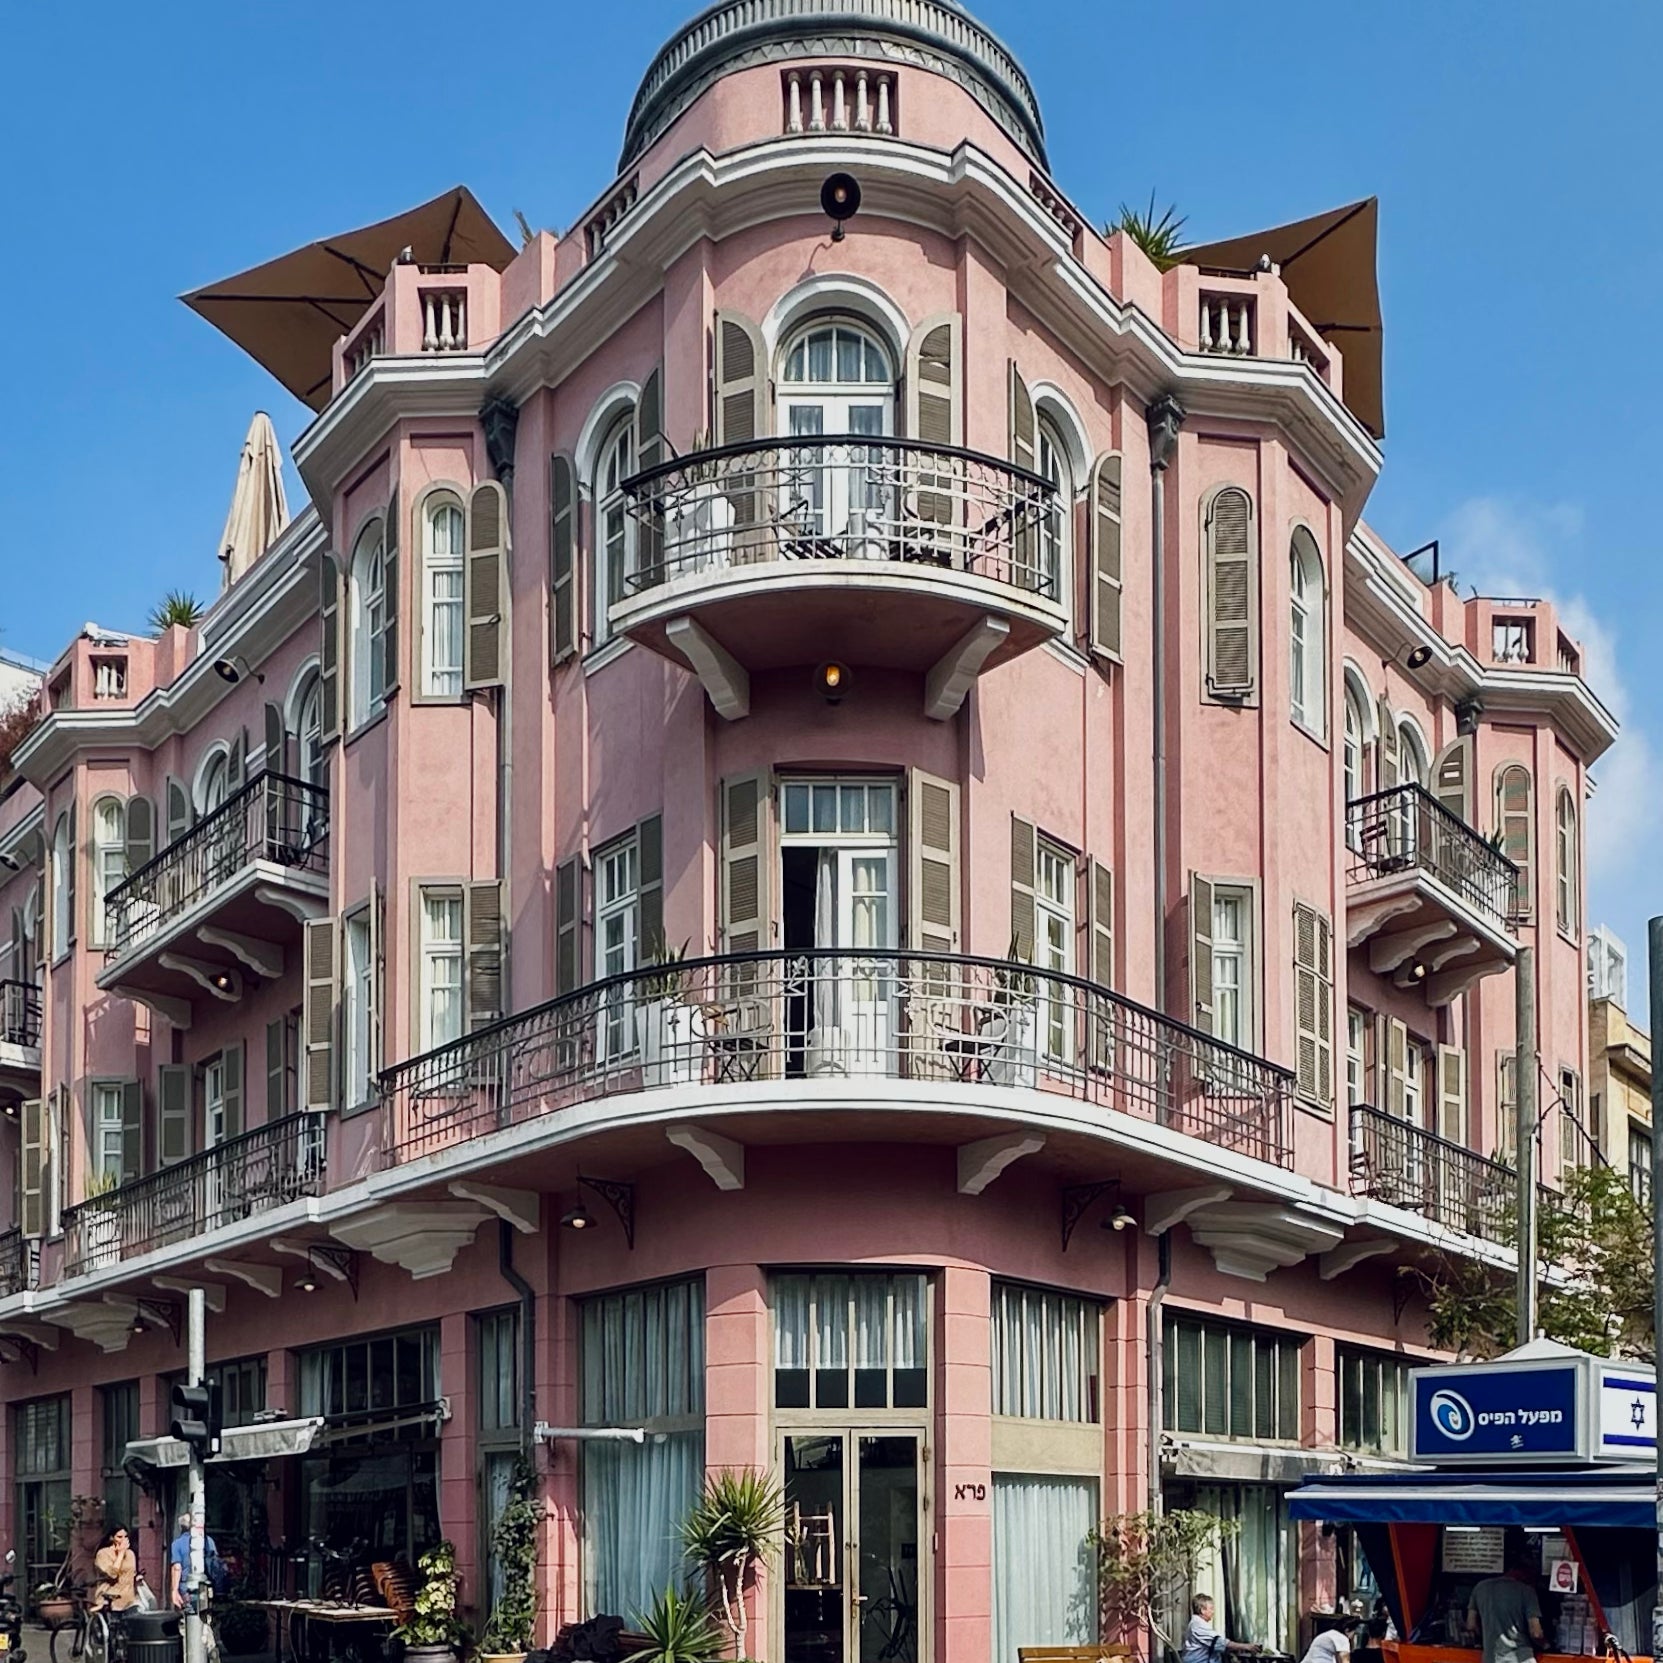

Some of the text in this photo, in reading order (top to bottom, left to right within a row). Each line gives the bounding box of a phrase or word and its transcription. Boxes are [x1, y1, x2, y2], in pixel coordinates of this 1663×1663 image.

[1478, 1408, 1563, 1426] מפעל הפיס
[954, 1483, 986, 1501] פרא
